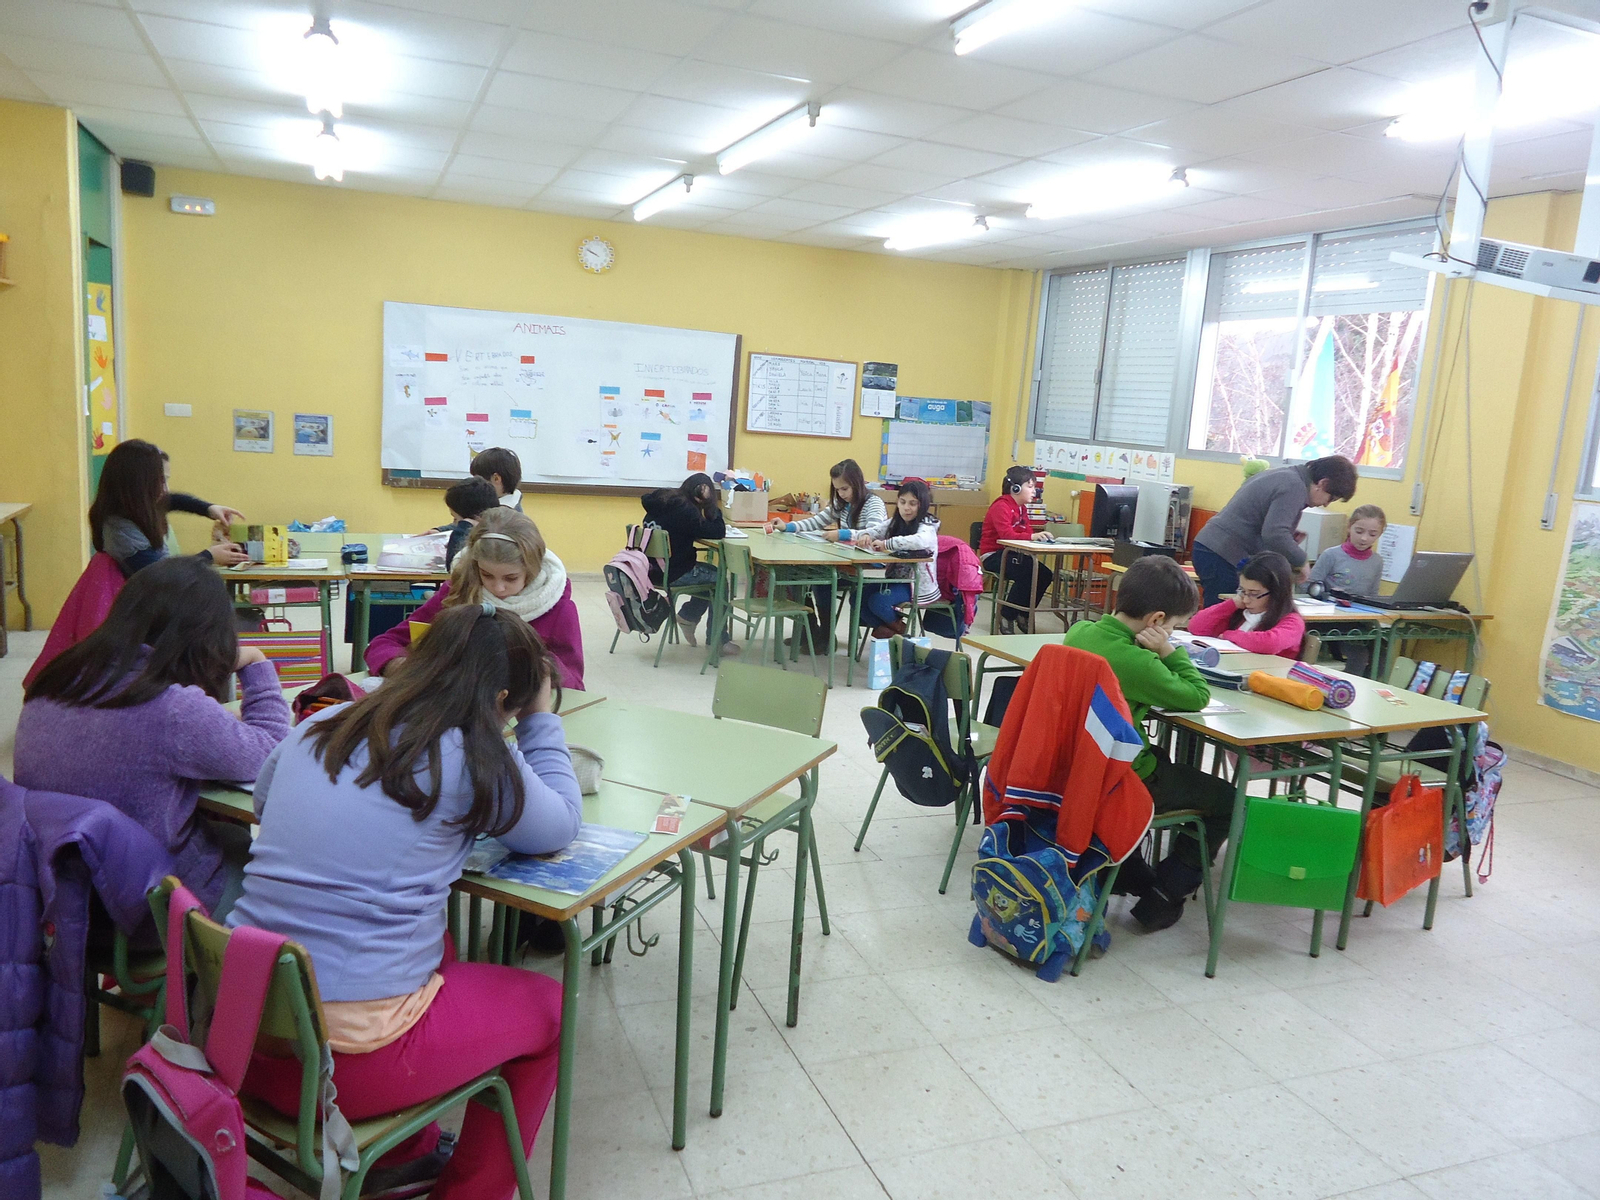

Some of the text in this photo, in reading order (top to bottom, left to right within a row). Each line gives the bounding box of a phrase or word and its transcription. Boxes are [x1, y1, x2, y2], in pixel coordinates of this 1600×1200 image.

[512, 322, 567, 336] ANIMAIS
[633, 362, 710, 376] INVERTEBRADOS
[927, 404, 946, 412] auga
